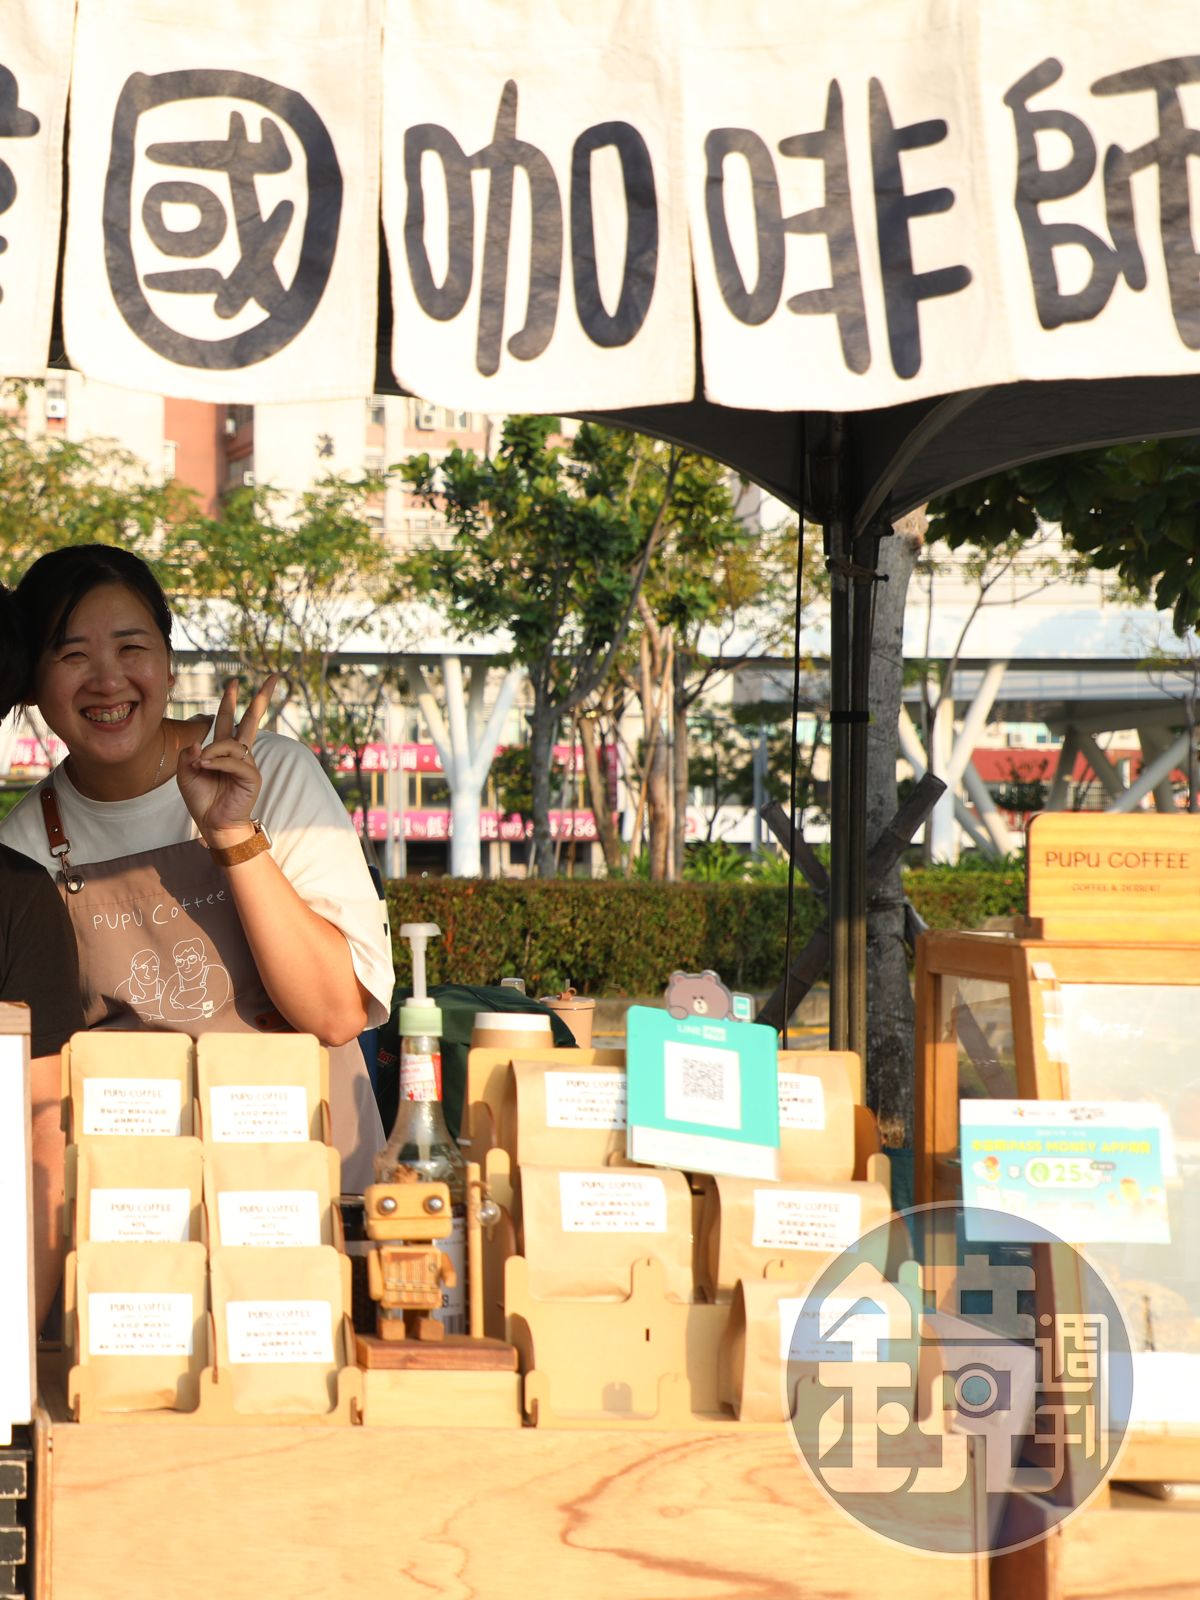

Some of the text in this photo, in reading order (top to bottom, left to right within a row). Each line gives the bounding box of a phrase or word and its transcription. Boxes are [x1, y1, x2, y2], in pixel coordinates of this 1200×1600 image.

[1045, 851, 1189, 869] PUPU COFFEE
[93, 909, 143, 931] PUPU
